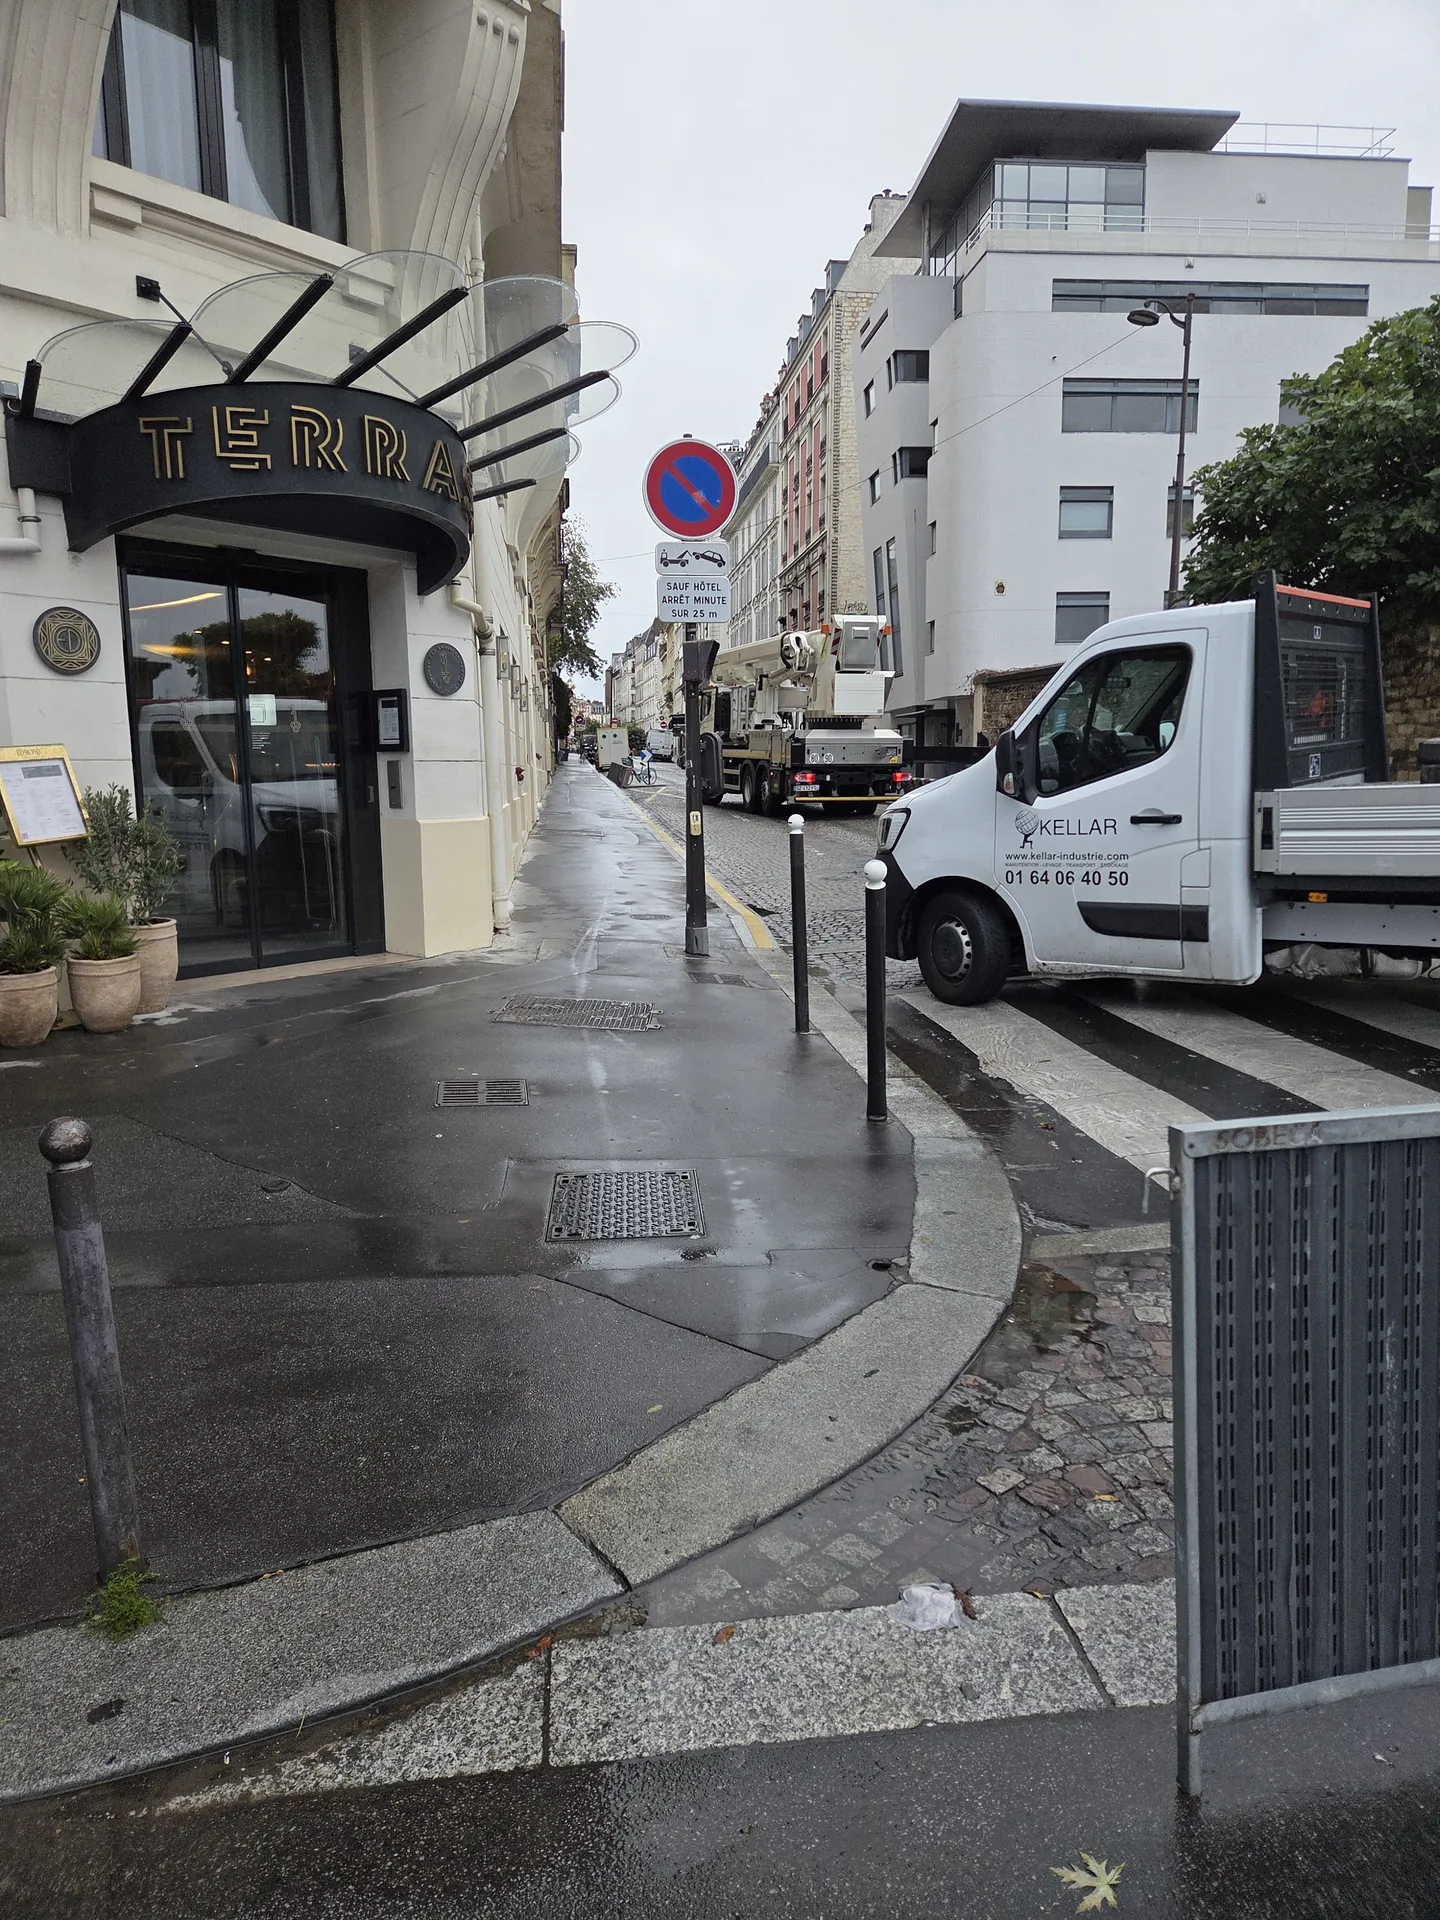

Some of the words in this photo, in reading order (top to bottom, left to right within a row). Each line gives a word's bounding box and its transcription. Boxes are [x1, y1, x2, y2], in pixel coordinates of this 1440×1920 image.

[139, 404, 474, 520] TERRA
[666, 582, 690, 591] SAUF
[693, 581, 722, 592] HÔTEL
[661, 594, 690, 604] ARRÊT
[693, 596, 727, 605] MINUTE
[671, 609, 689, 618] SUR
[693, 609, 705, 618] 25
[811, 754, 819, 763] 80
[824, 754, 833, 763] 90
[1040, 818, 1117, 836] KELLAR
[1005, 852, 1129, 861] www.kellar-industrie.com
[1005, 869, 1022, 885] 01
[1030, 870, 1049, 885] 64
[1055, 870, 1075, 886] 06
[1081, 870, 1101, 886] 40
[1108, 871, 1129, 886] 50
